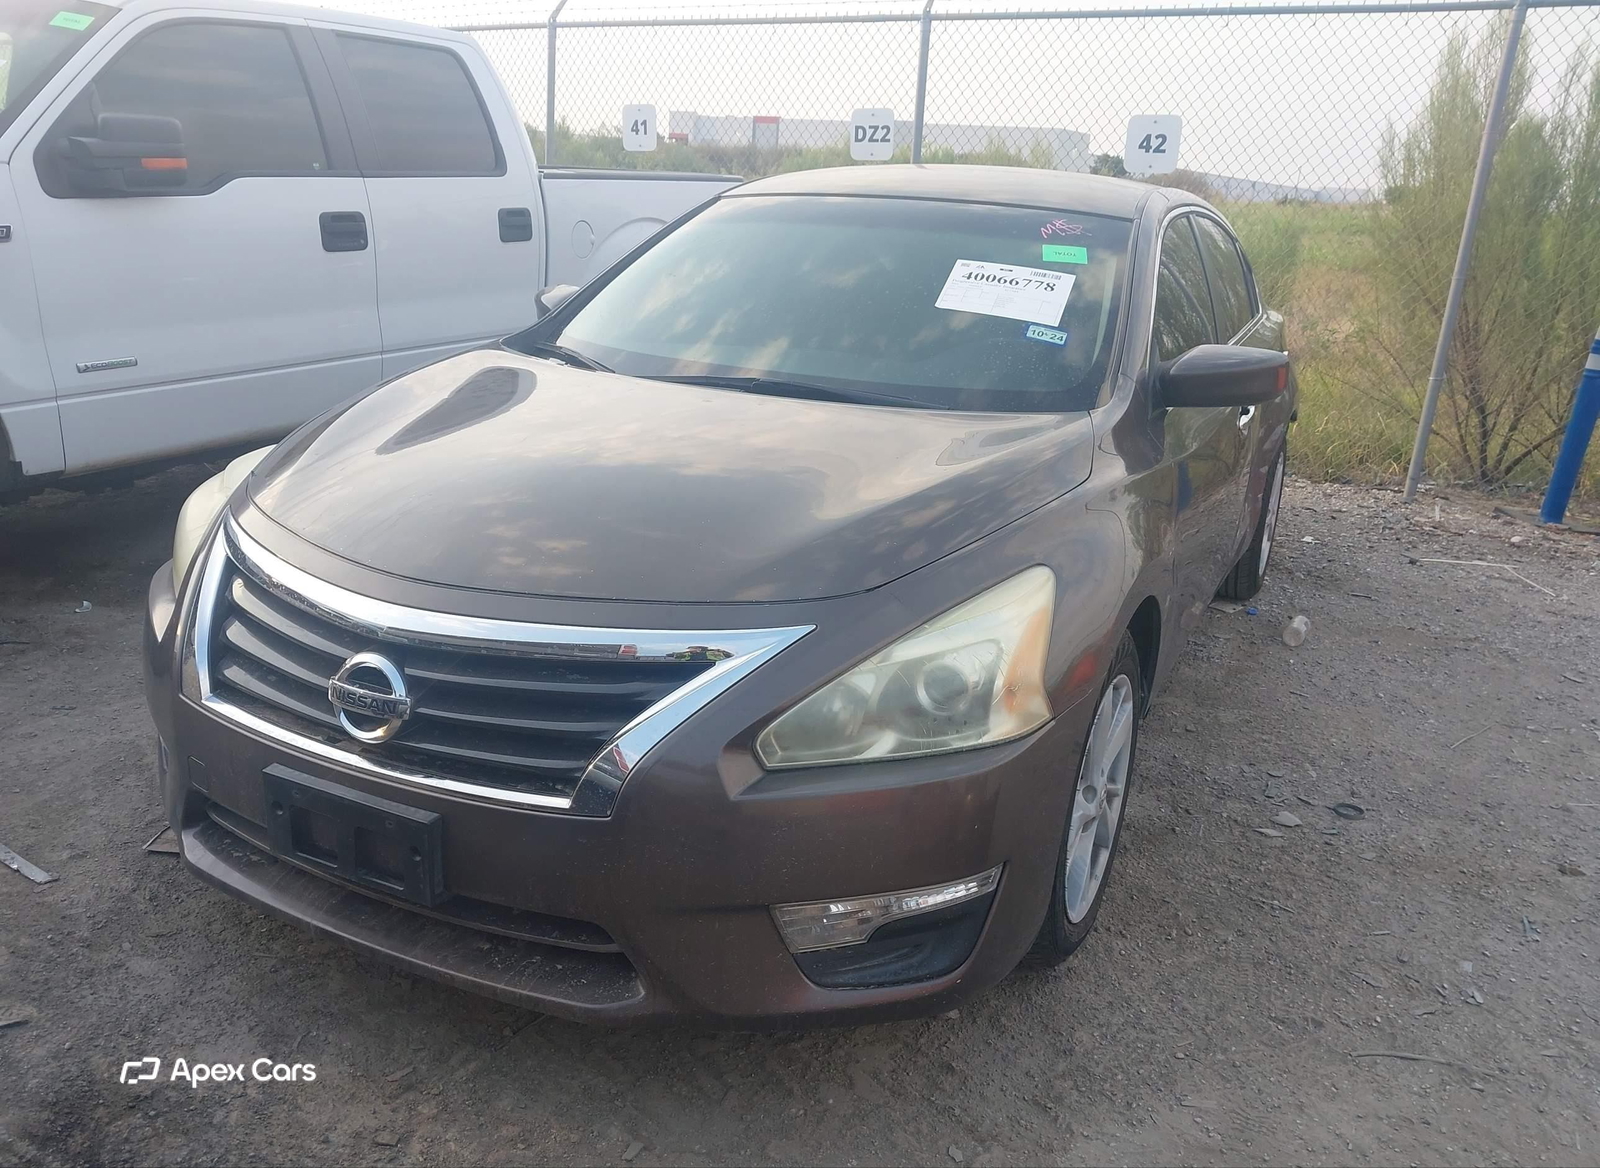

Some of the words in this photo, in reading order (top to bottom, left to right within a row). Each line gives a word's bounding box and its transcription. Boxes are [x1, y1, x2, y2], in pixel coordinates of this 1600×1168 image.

[630, 119, 648, 136] 41
[854, 124, 891, 143] DZ2
[1137, 133, 1168, 154] 42
[961, 271, 1057, 293] 40066778
[1030, 329, 1045, 338] 10
[1049, 333, 1064, 342] 24
[331, 682, 397, 717] NISSAN
